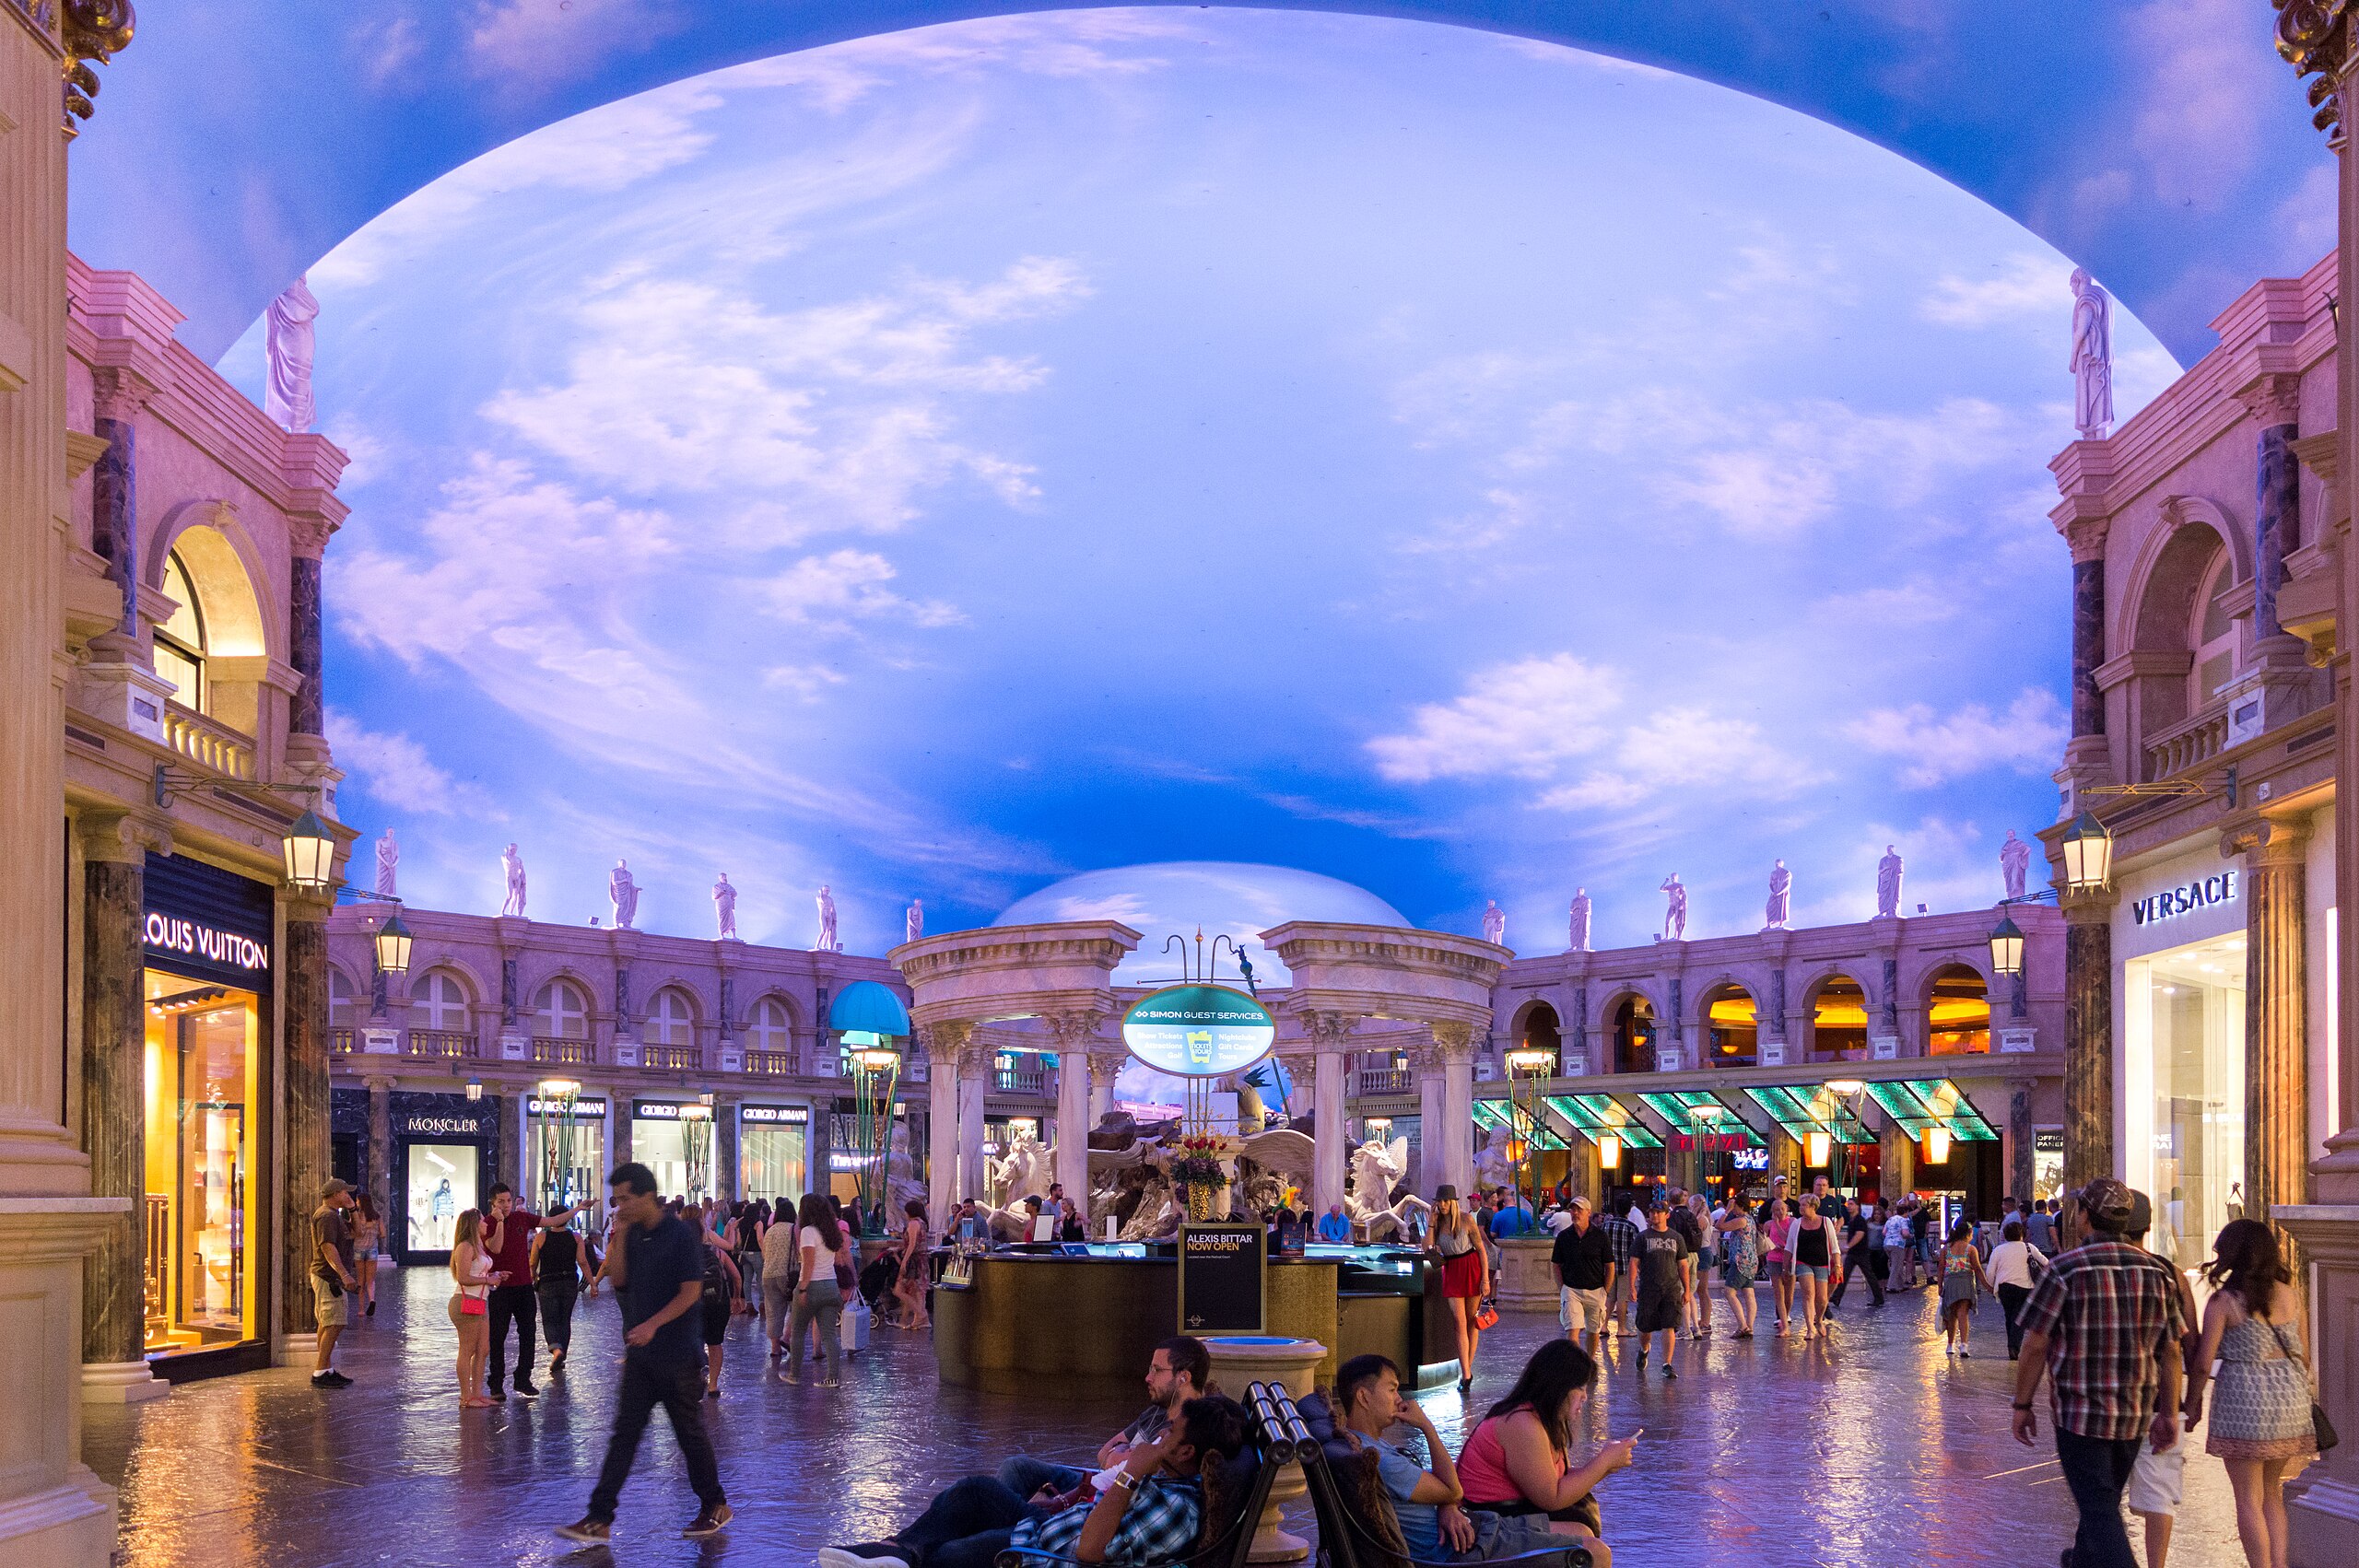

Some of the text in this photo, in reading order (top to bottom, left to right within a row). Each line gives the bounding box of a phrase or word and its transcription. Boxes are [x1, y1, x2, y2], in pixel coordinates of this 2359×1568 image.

[2132, 872, 2236, 925] VERSACE
[196, 925, 268, 969] VUITTON
[1149, 1011, 1264, 1021] SIMON GUEST SERVICES
[1157, 1032, 1183, 1040] Tickets
[1218, 1033, 1257, 1042] Nightclubs
[1144, 1041, 1183, 1049] Attractions
[1217, 1042, 1232, 1050] Gift
[1167, 1051, 1183, 1059] Golf
[1217, 1052, 1238, 1060] Tours
[640, 1105, 677, 1117] GIORGIO
[743, 1108, 807, 1121] GIORGIO ARMANI
[408, 1117, 478, 1132] MONCLER
[1187, 1235, 1253, 1243] ALEXIS BITTAR
[1187, 1242, 1239, 1251] NOW OPEN
